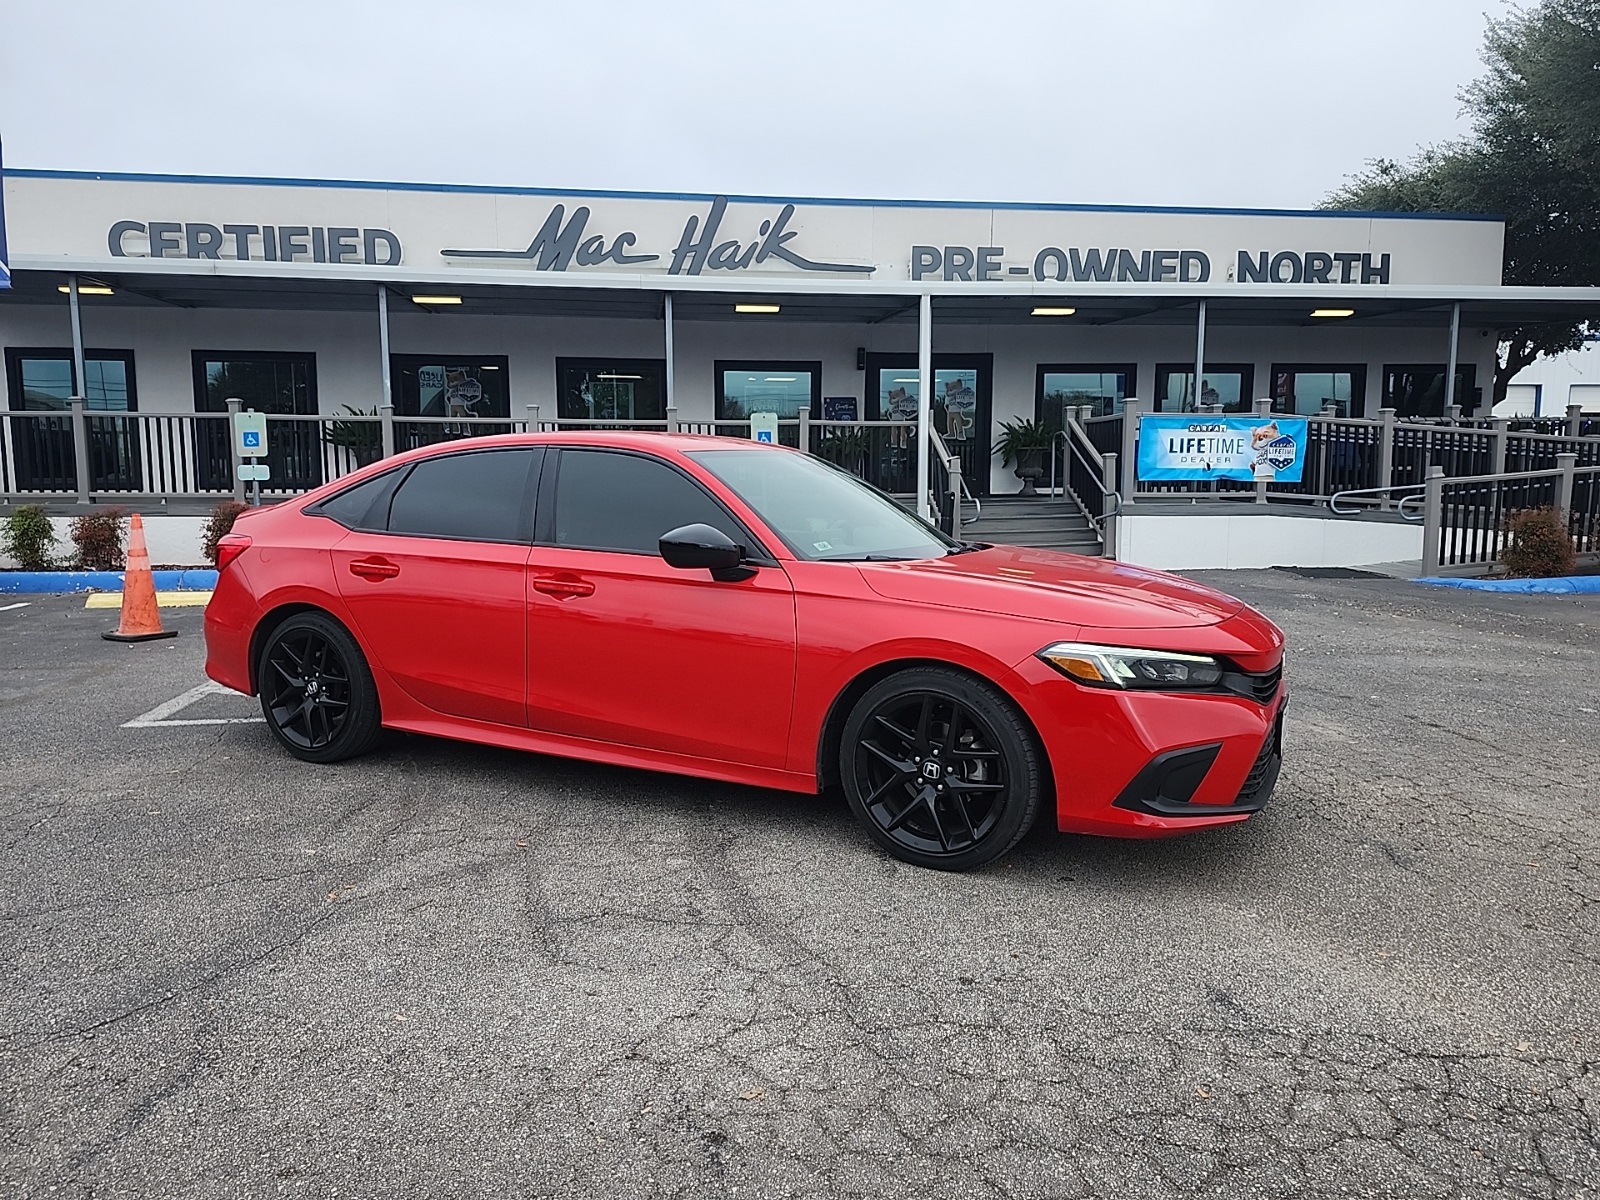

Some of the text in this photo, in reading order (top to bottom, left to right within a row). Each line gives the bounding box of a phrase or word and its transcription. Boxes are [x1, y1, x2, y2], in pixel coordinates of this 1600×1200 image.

[108, 220, 403, 266] CERTIFIED
[441, 195, 876, 276] Mac Haik
[911, 245, 1391, 285] PRE-OWNED NORTH
[1169, 437, 1245, 454] LIFETIME
[1188, 424, 1227, 433] CARFAX
